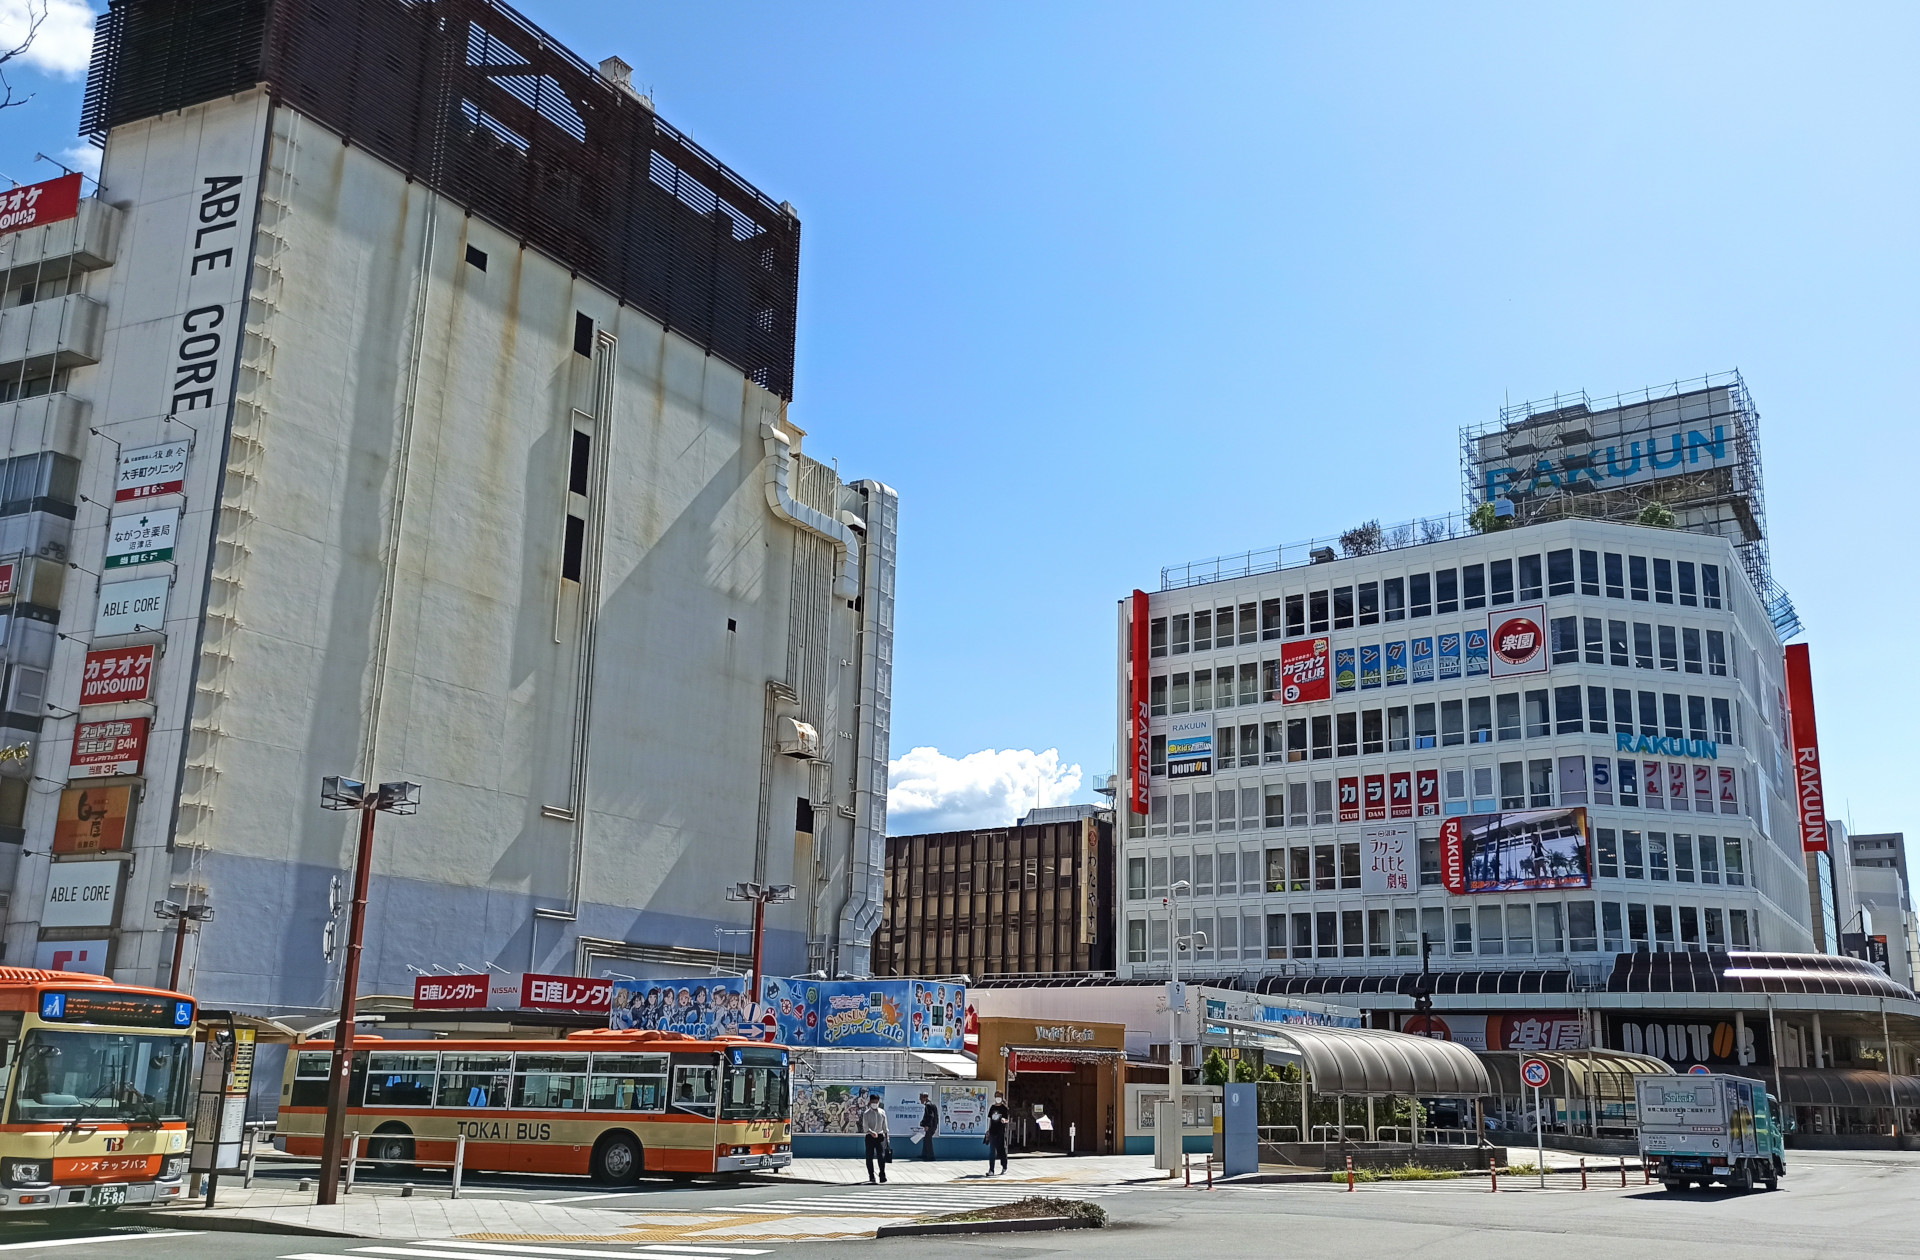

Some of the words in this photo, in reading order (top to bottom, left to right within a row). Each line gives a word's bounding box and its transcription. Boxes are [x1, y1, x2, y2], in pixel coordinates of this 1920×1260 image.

[190, 175, 243, 277] ABLE
[170, 304, 225, 415] CORE
[121, 461, 184, 482] 大手町クリニック
[1486, 425, 1726, 502] RAKUUN
[115, 524, 170, 543] ながつき薬局
[129, 539, 152, 550] 沼津店
[103, 602, 128, 617] ABLE
[133, 597, 161, 613] CORE
[1337, 633, 1486, 667] ジャングルジム
[1501, 632, 1534, 652] 楽園
[85, 653, 151, 680] カラオケ
[1283, 656, 1326, 676] カラオケ
[1293, 667, 1325, 684] CLUB
[84, 675, 145, 696] JOYSOUND
[80, 723, 131, 740] ネットカフェ
[1172, 721, 1207, 731] RAKUUN
[77, 739, 116, 755] コミック
[117, 737, 138, 750] 24H
[1139, 701, 1148, 804] RAKUEN
[1616, 732, 1718, 760] RAKUUN
[103, 764, 118, 774] 3F
[1172, 761, 1208, 774] DOUTOR
[1341, 777, 1435, 803] カラオケ
[1798, 747, 1825, 842] RAKUUN
[1340, 812, 1358, 820] CLUB
[1392, 808, 1411, 816] RESORT
[1424, 806, 1434, 814] 5F
[1370, 839, 1404, 856] ラクーン
[1446, 822, 1460, 888] RAKUUN
[1371, 856, 1404, 872] よしもと
[1386, 873, 1408, 889] 劇場
[51, 887, 77, 902] ABLE
[83, 885, 110, 900] CORE
[420, 984, 483, 1000] 日産レンタカー
[457, 1121, 509, 1139] TOKAI
[516, 1123, 551, 1140] BUS
[104, 1137, 125, 1152] TB
[1711, 1138, 1721, 1149] 6
[70, 1160, 148, 1172] ノンステップバス
[97, 1191, 125, 1205] 15-88
